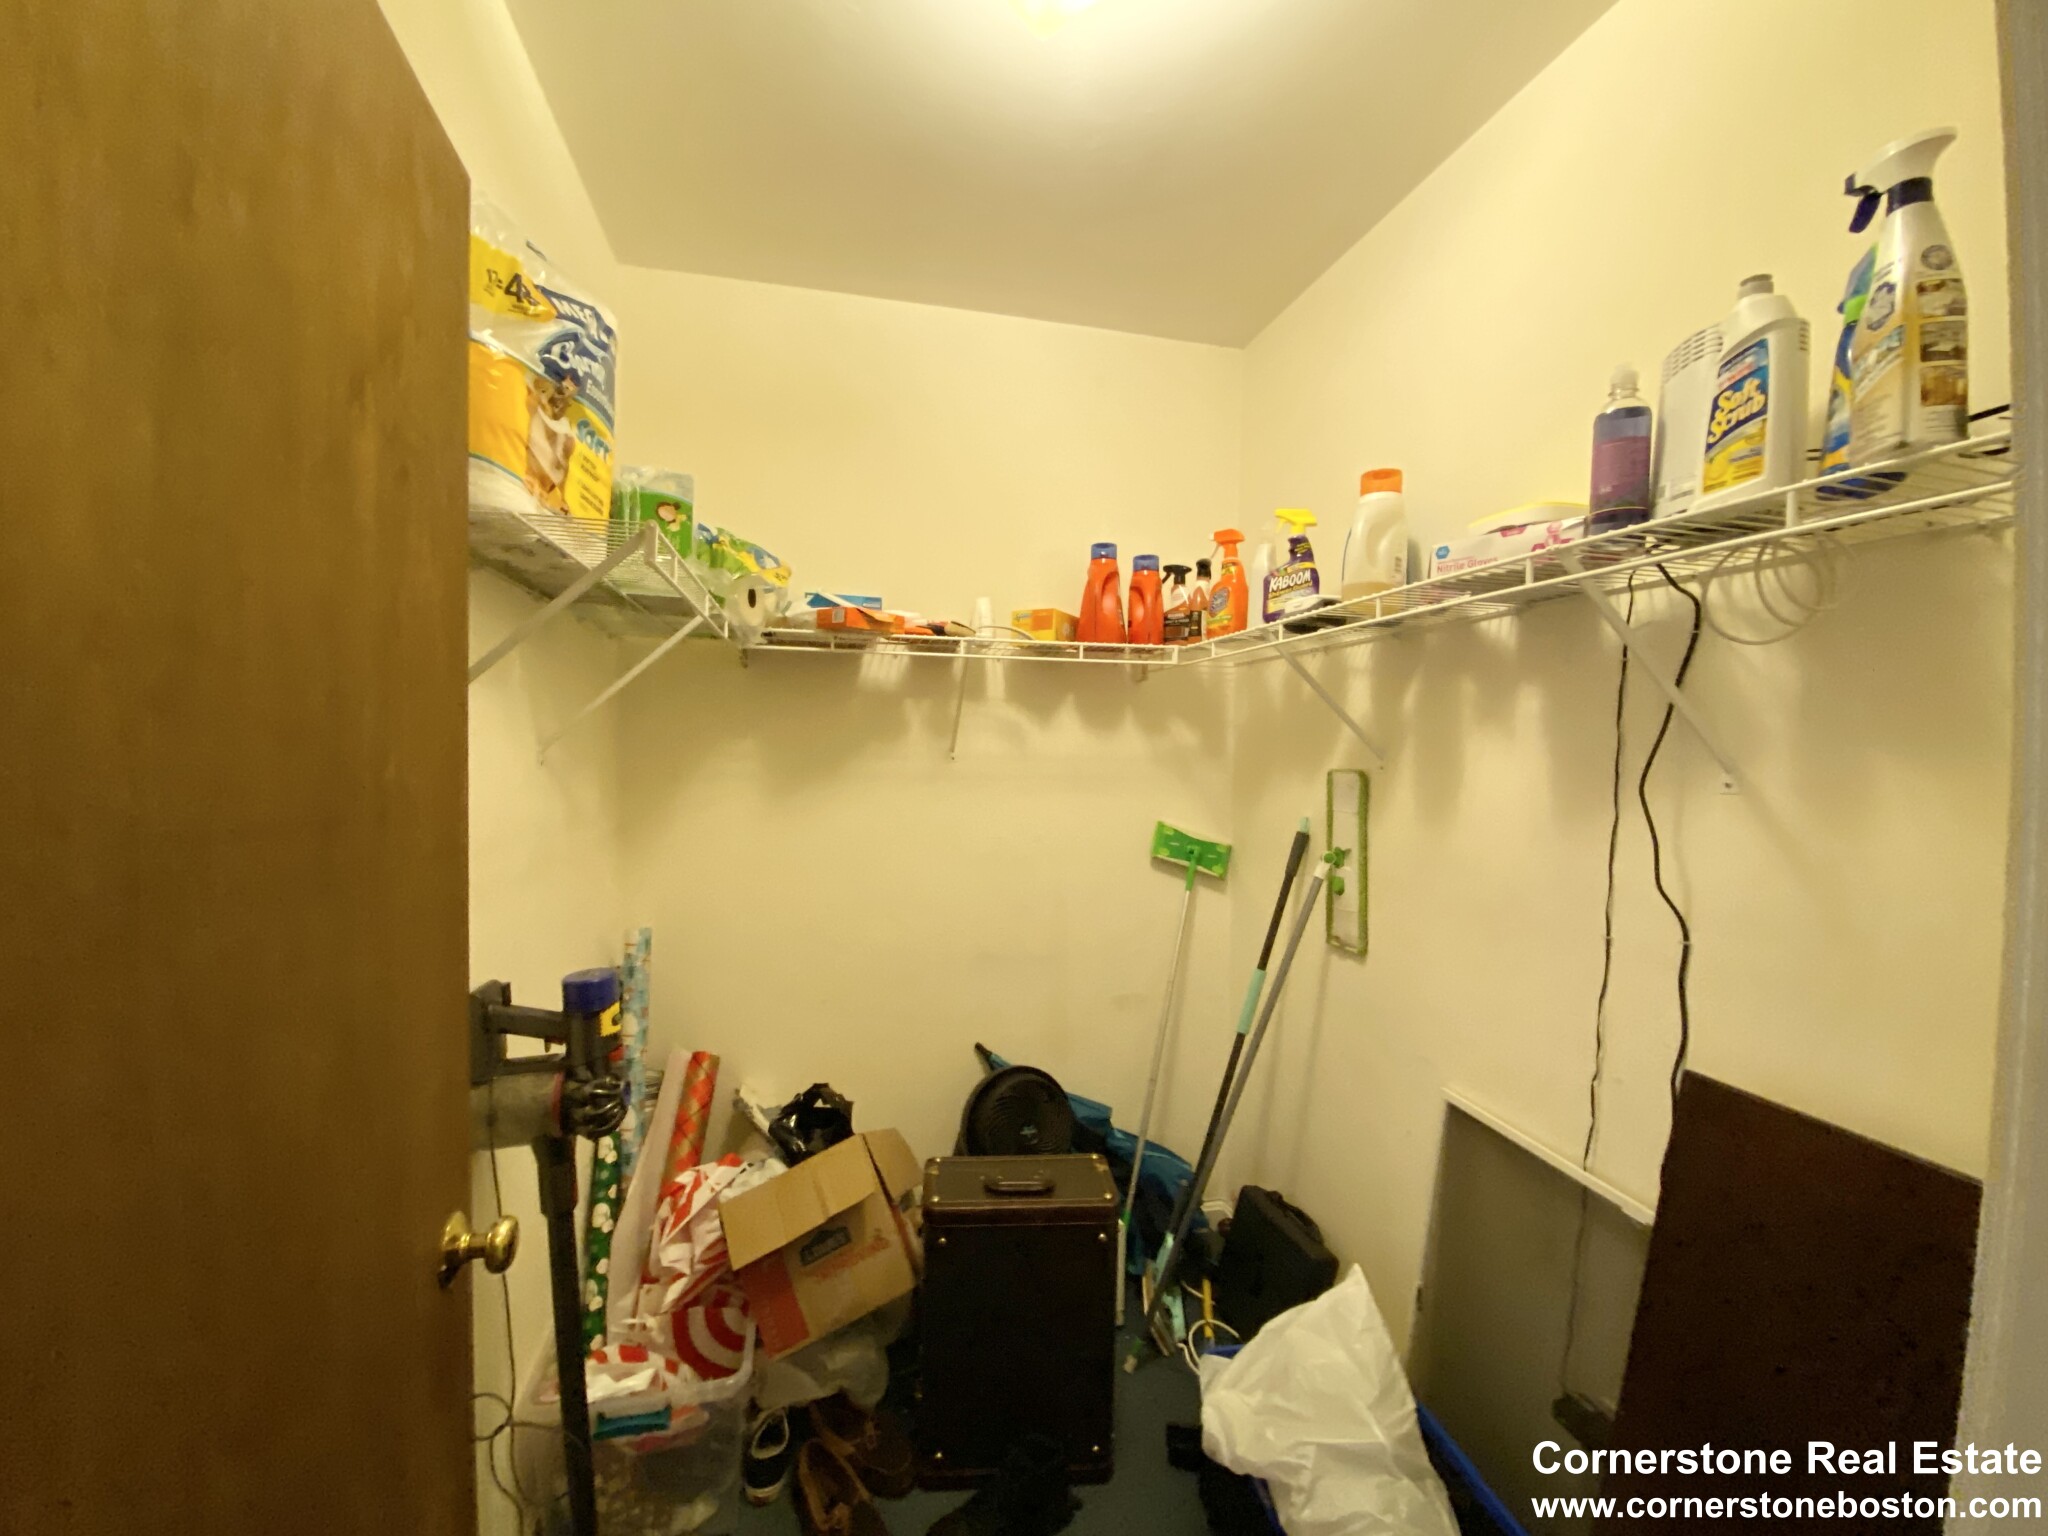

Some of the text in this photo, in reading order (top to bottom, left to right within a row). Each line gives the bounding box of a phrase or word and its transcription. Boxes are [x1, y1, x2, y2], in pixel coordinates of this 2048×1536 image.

[1718, 377, 1761, 411] Soft
[1707, 394, 1766, 444] Scrub
[1268, 569, 1312, 593] KABOOM
[1436, 561, 1466, 574] Nitrile
